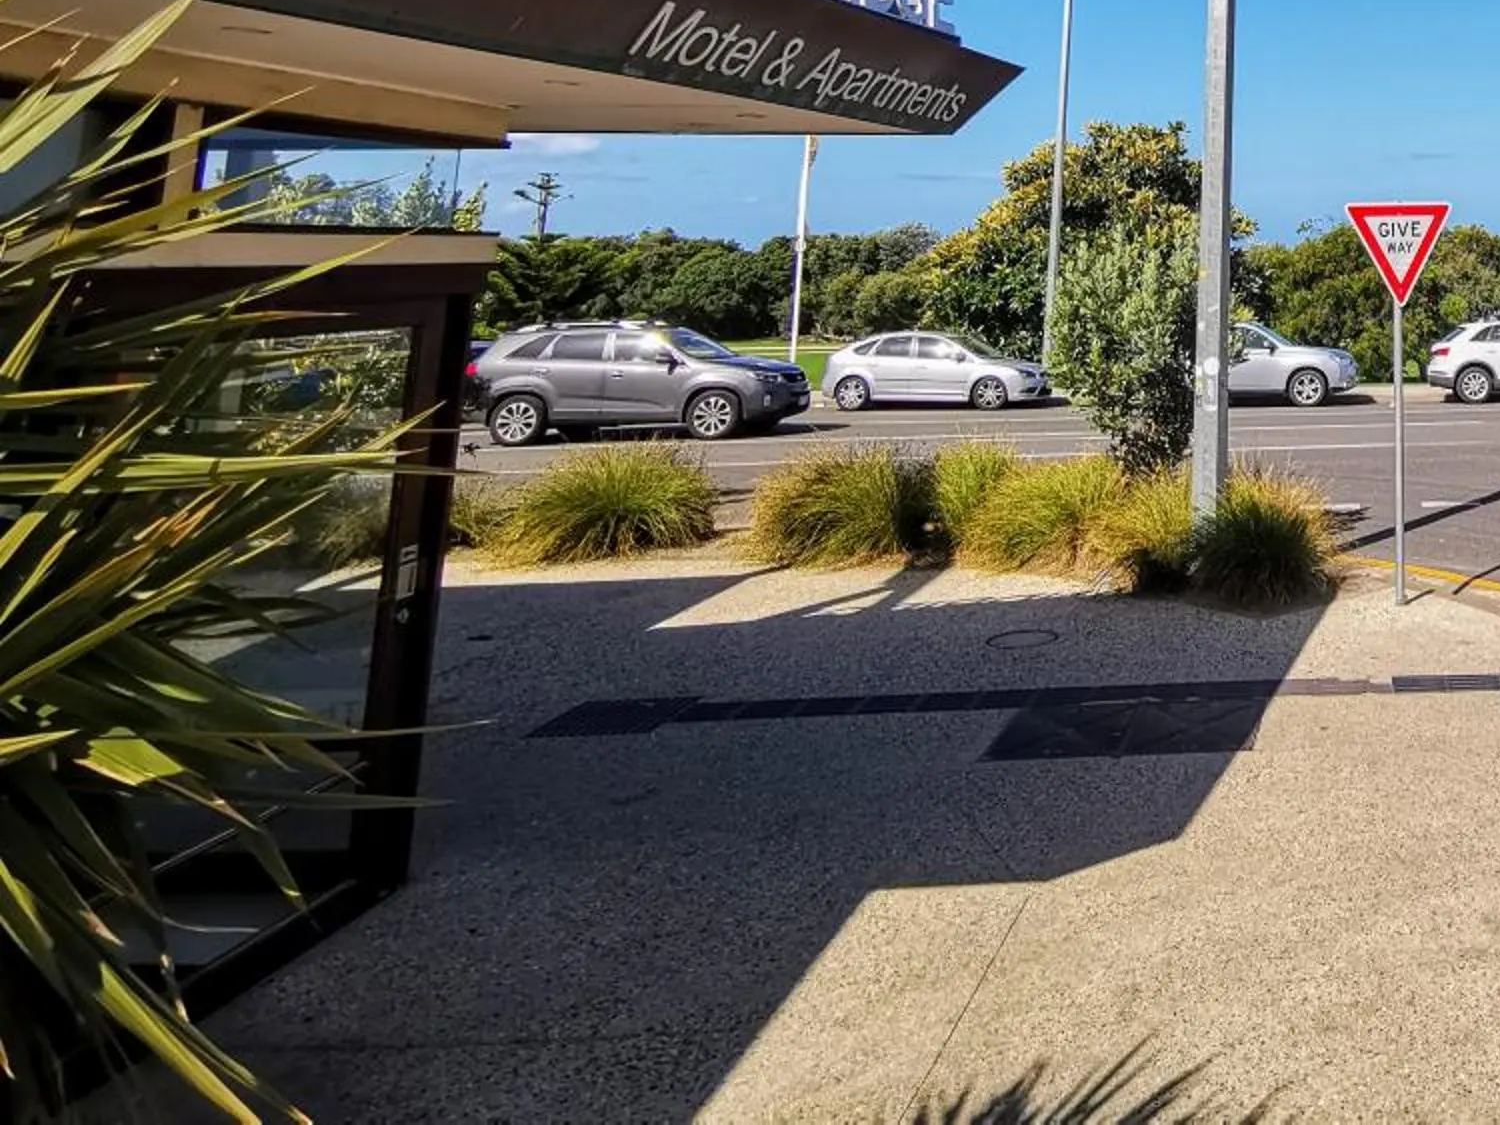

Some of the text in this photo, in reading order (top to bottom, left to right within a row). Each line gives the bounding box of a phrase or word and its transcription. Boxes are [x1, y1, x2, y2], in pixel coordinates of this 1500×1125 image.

[628, 0, 967, 124] Motel & Apartments
[1378, 221, 1422, 239] GIVE
[1387, 242, 1413, 254] WAY
